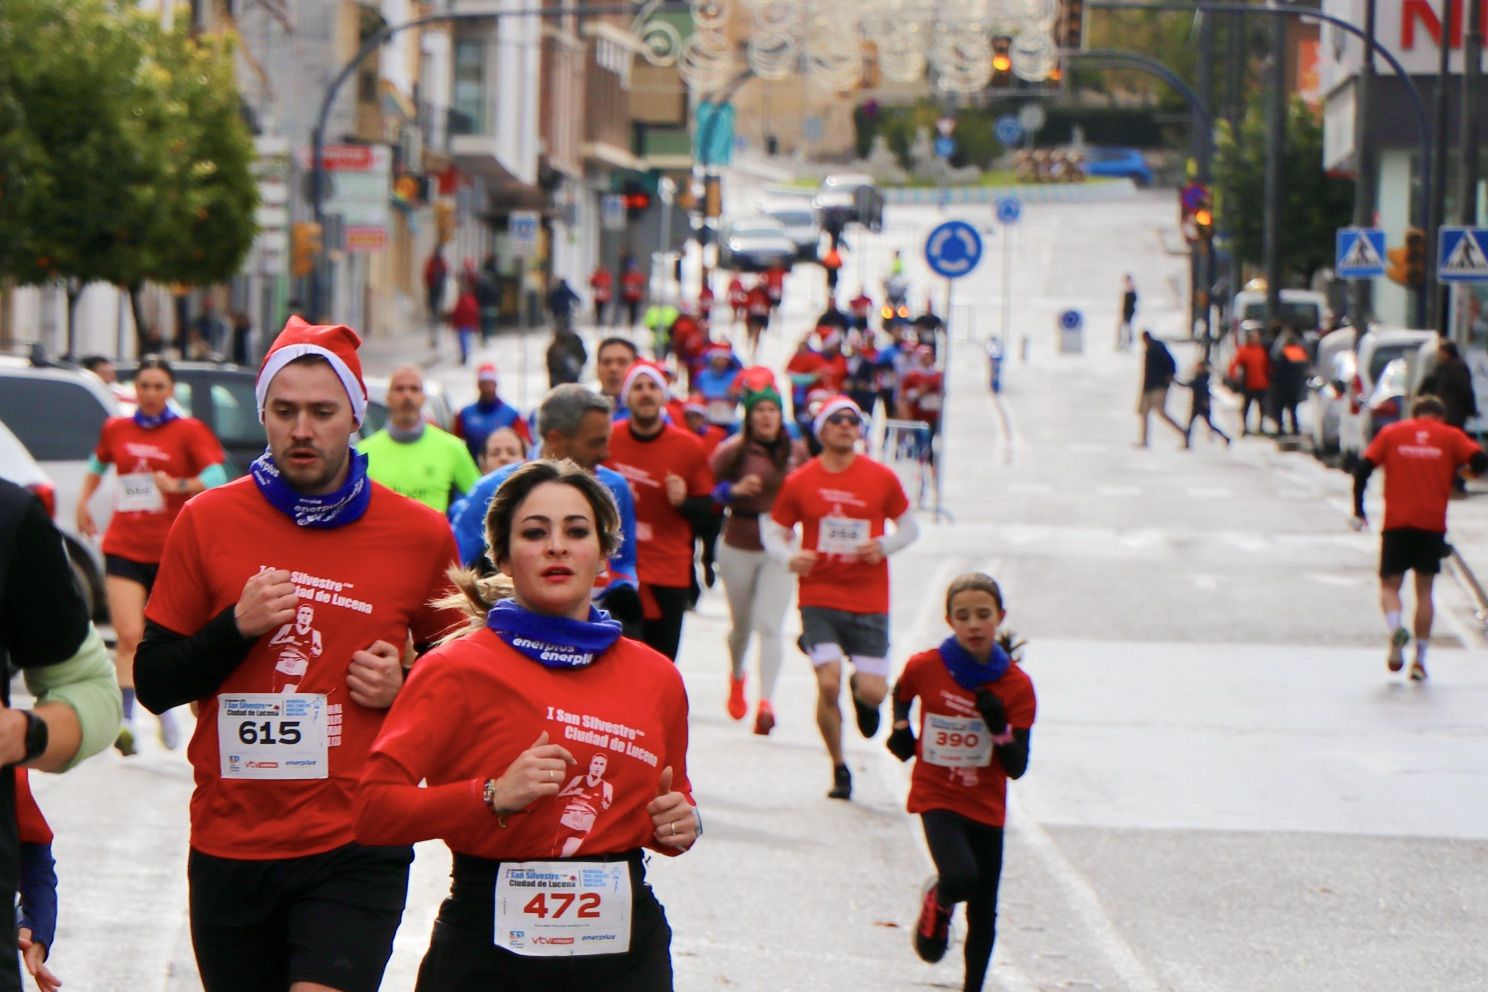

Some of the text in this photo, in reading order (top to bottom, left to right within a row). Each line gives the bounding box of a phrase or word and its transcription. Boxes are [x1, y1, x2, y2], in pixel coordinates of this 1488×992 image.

[290, 571, 344, 592] Silvestre
[315, 590, 332, 603] de
[332, 593, 373, 614] Lucena
[239, 720, 302, 745] 615
[547, 706, 555, 720] I
[556, 709, 581, 726] San
[582, 714, 636, 740] Silvestre
[565, 725, 610, 748] Ciudad
[610, 737, 626, 753] de
[935, 731, 979, 749] 390
[509, 879, 577, 888] Ciudad de Lucena
[510, 871, 525, 879] San
[523, 892, 602, 919] 472
